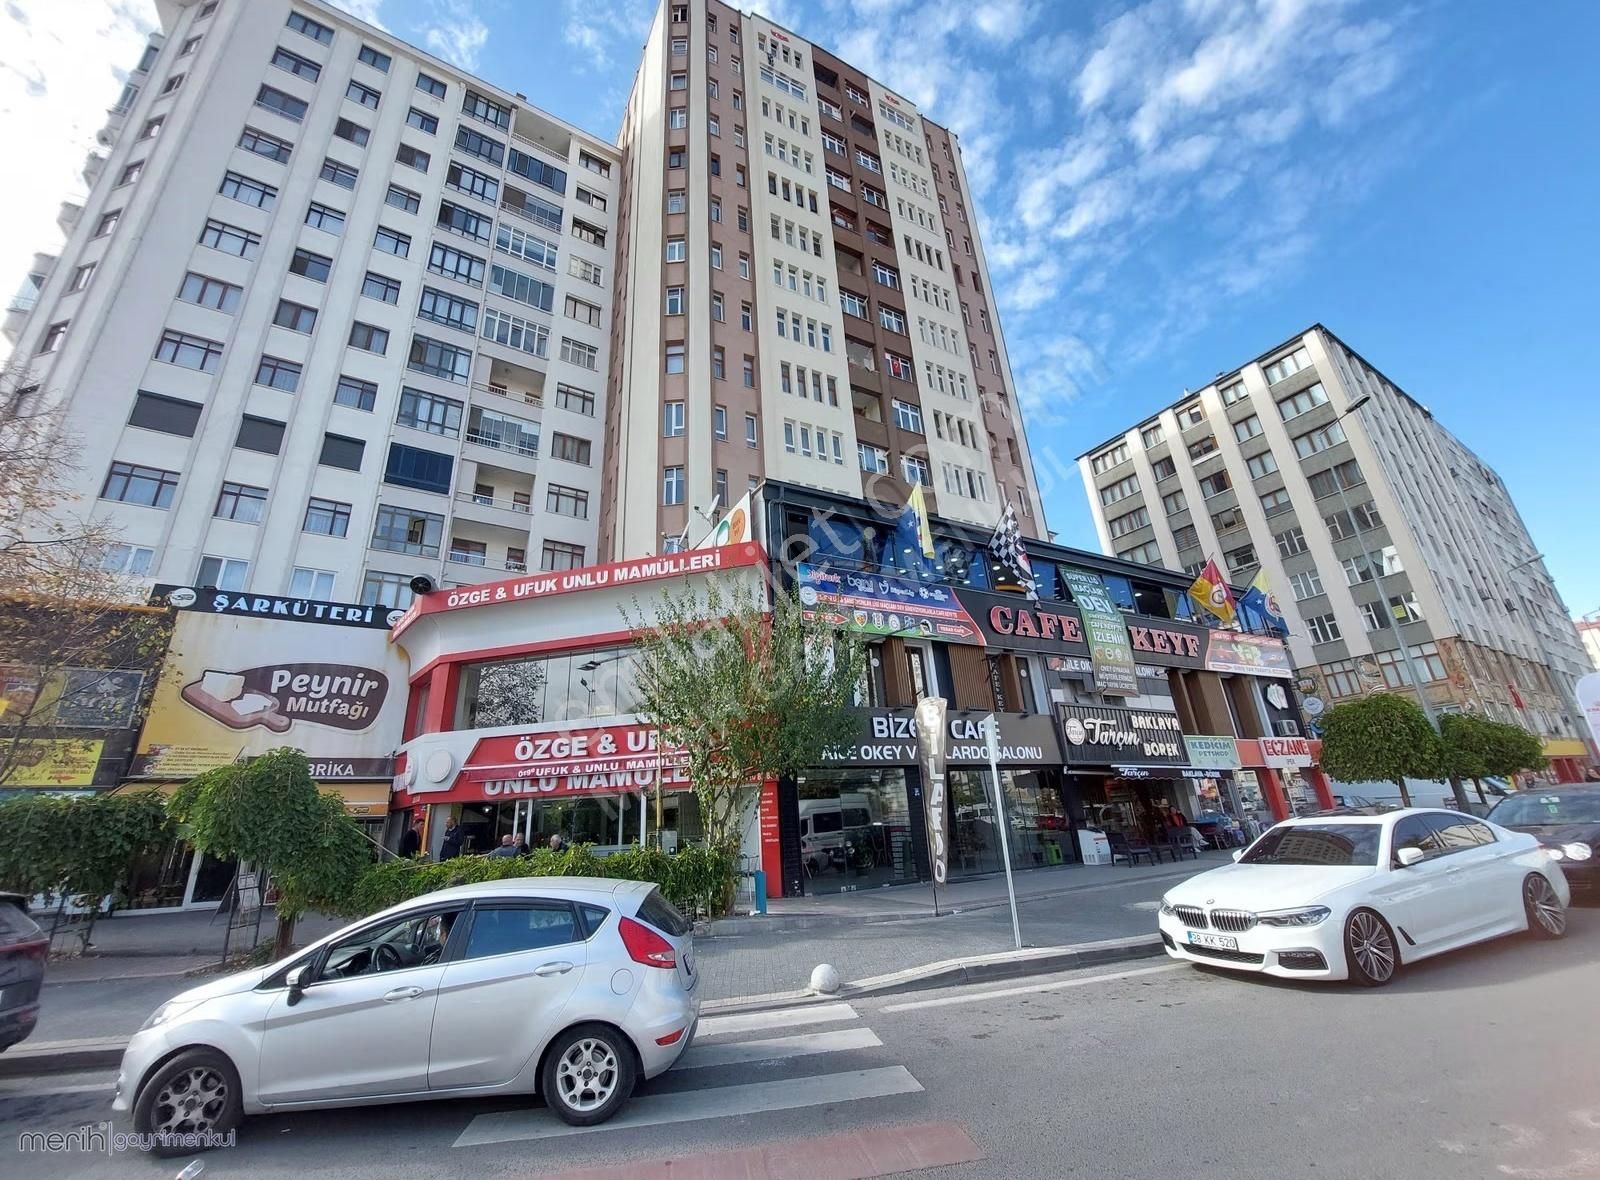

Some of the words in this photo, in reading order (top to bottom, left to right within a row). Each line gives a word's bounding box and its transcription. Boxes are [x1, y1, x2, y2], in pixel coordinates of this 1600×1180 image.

[447, 584, 490, 608] ÖZGE
[495, 586, 507, 600] &
[513, 578, 558, 597] UFUK
[562, 570, 608, 590] UNLU
[613, 549, 721, 583] MAMÜLLERİ
[212, 593, 374, 624] ŞARKÜTERİ
[1077, 594, 1113, 614] DEV
[989, 605, 1083, 644] CAFE
[1127, 624, 1200, 658] KEYF
[270, 668, 379, 700] Peynir
[285, 695, 369, 721] Mutfağı
[1131, 714, 1180, 731] BAKLAVA
[1083, 717, 1140, 751] Tarçın
[514, 736, 588, 761] ÖZGE
[597, 733, 617, 754] &
[860, 745, 902, 760] OKEY
[1143, 739, 1180, 757] BÖREK
[1263, 738, 1310, 756] ECZANE
[307, 761, 355, 777] BRİKA
[535, 766, 569, 777] UFUK
[572, 765, 581, 774] &
[585, 761, 619, 773] UNLU
[1203, 936, 1217, 946] KK
[1218, 937, 1236, 949] 520
